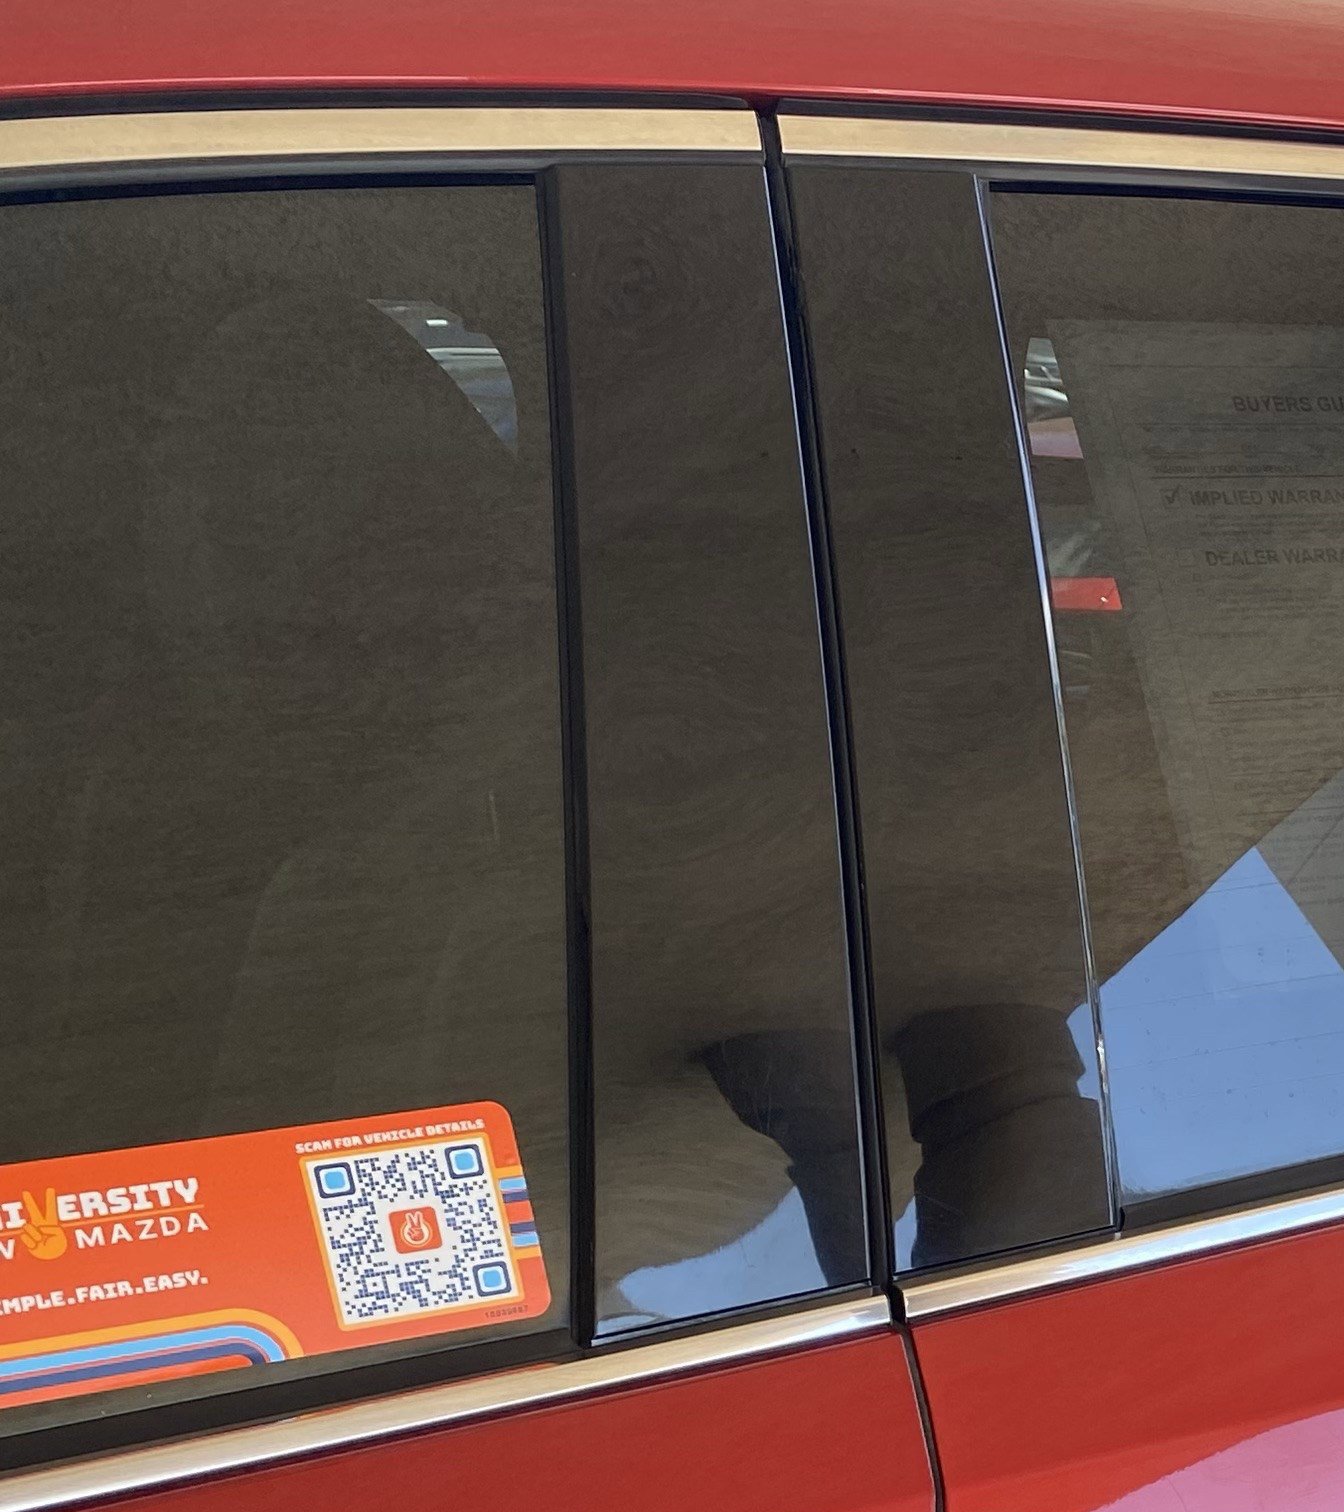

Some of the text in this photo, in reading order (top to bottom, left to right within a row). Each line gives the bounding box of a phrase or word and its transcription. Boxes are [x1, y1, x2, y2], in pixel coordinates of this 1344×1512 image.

[1232, 396, 1312, 413] BUYERS
[1189, 489, 1264, 507] IMPLIED
[1205, 549, 1279, 567] DEALER
[295, 1119, 485, 1154] SCAN FOR VEHICLE DETAILS
[0, 1177, 198, 1230] IVERSITY
[75, 1213, 209, 1249] MAZDA
